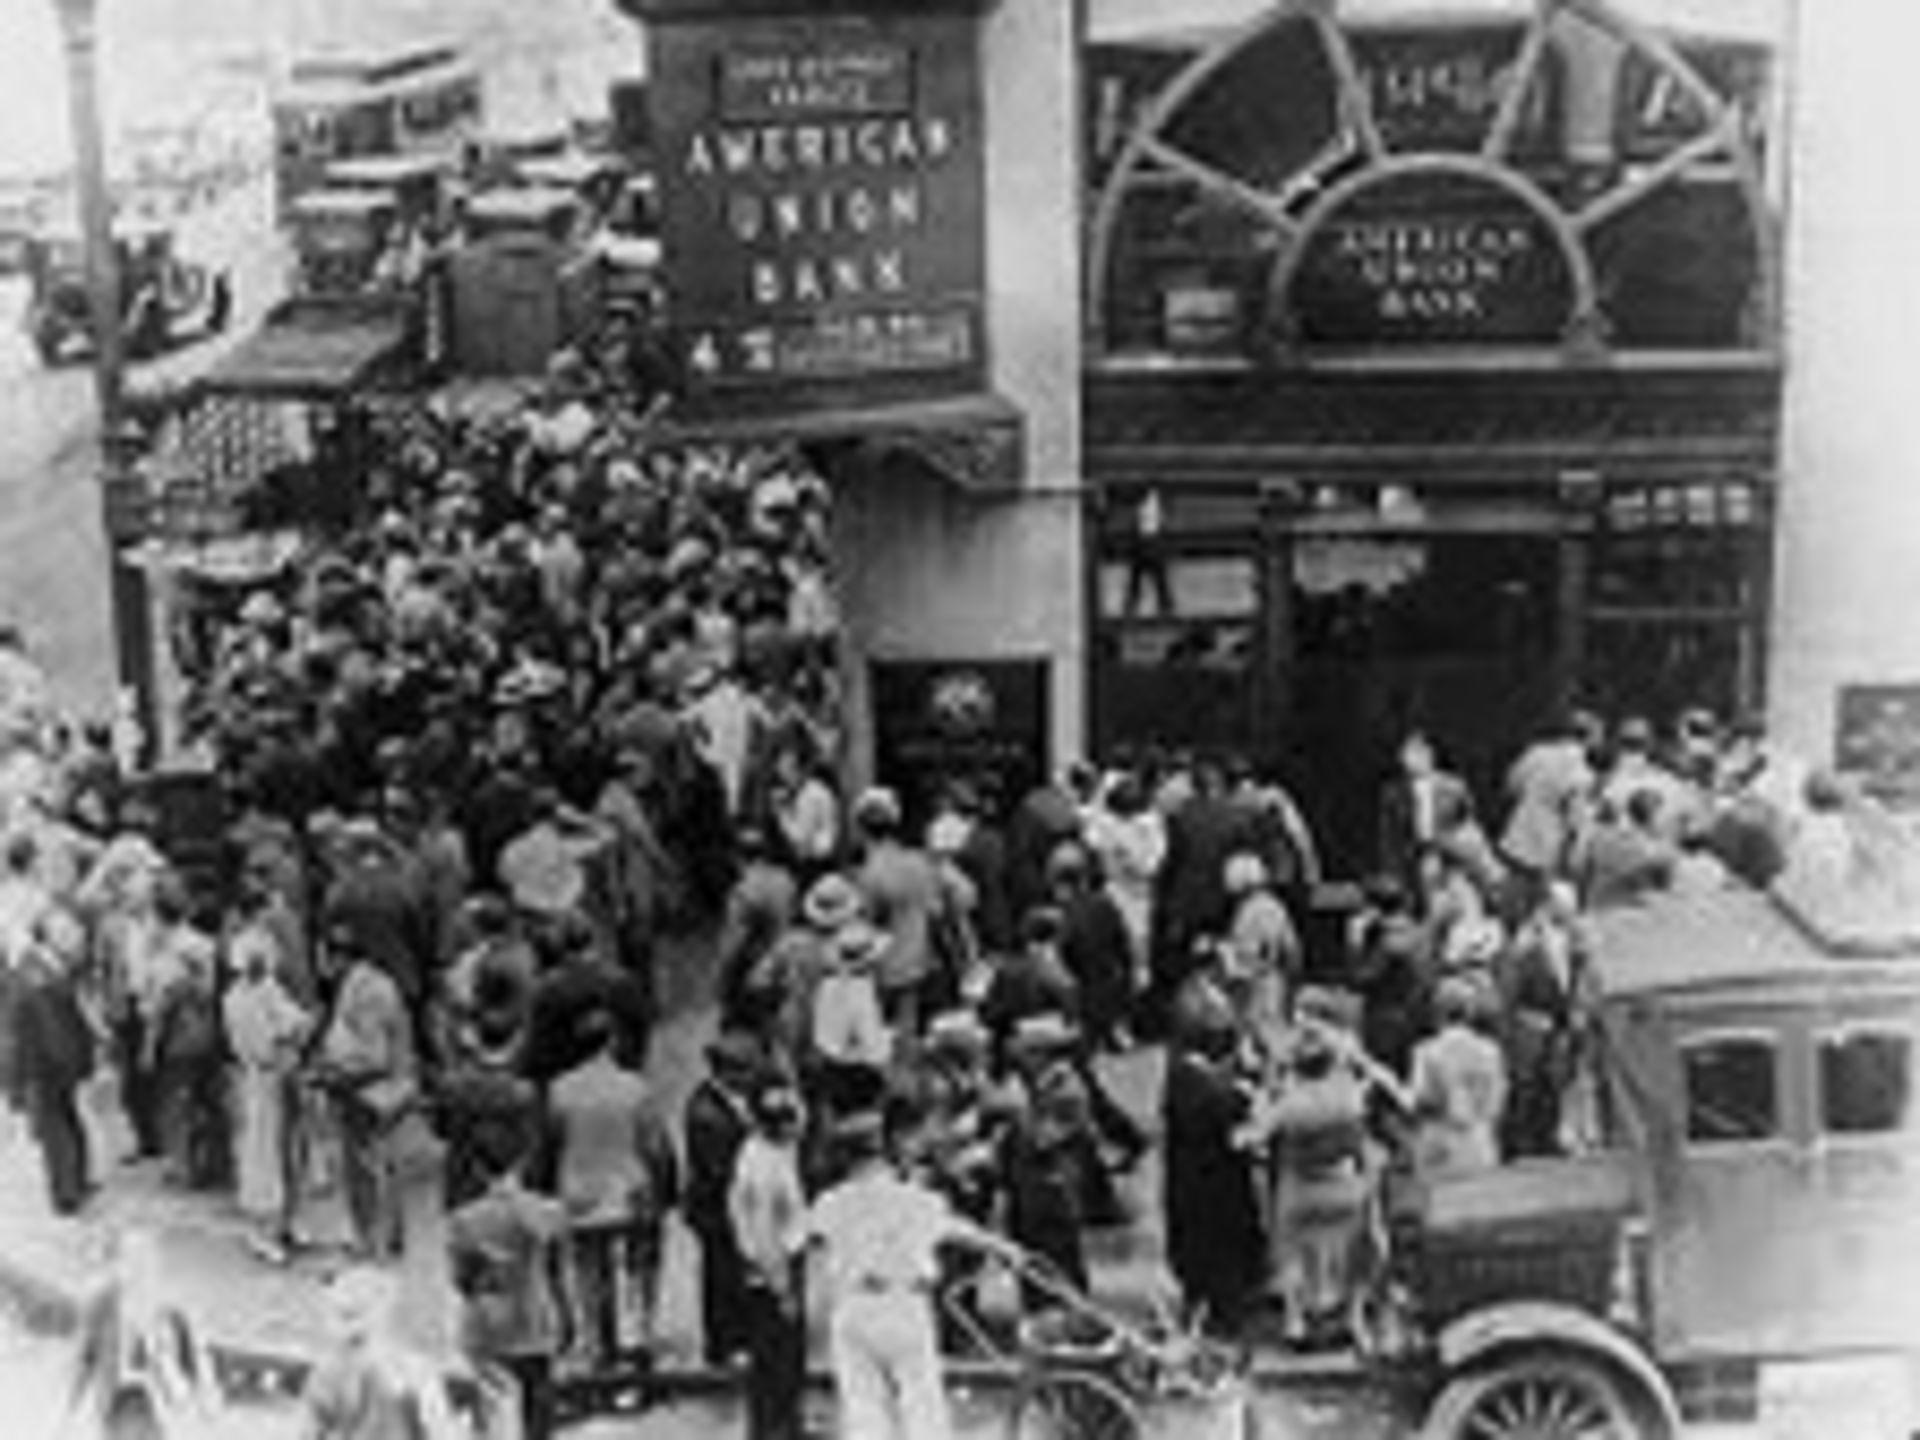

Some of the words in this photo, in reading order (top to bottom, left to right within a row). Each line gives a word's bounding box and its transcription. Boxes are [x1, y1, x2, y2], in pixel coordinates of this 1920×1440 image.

[686, 118, 953, 174] AMERICAN
[729, 187, 918, 242] UNION
[753, 250, 902, 303] BANK
